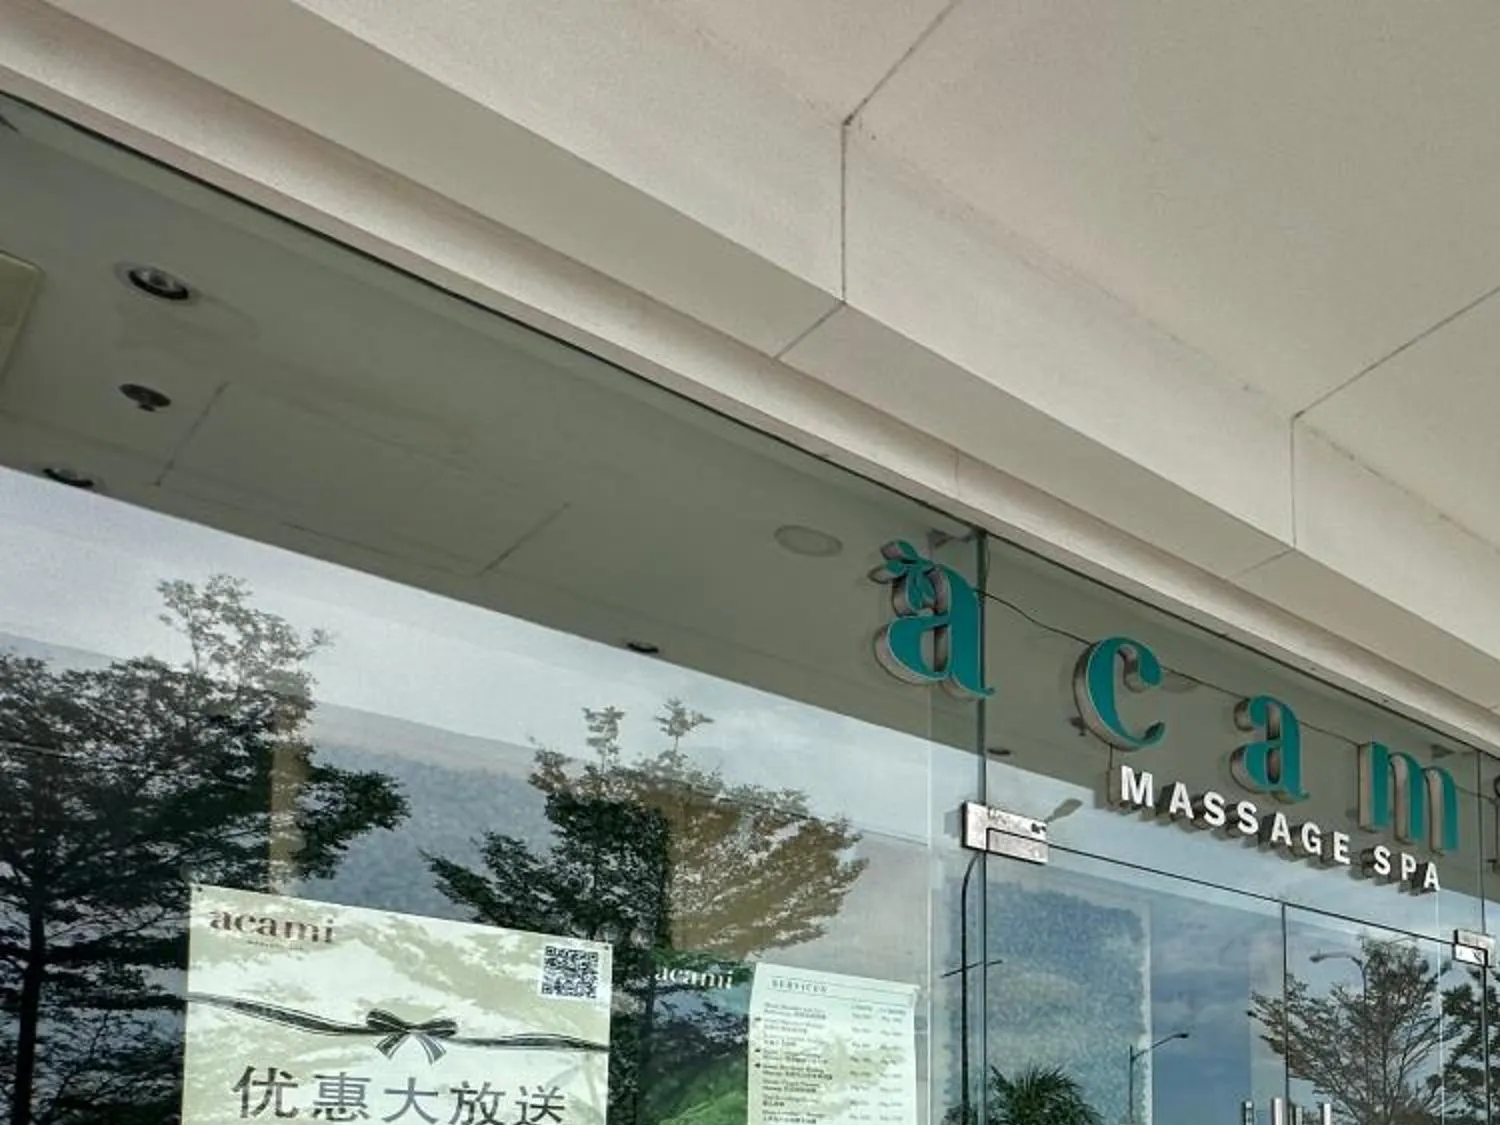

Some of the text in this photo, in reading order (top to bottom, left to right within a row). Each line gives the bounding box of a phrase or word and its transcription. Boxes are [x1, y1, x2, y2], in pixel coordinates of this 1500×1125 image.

[1120, 765, 1441, 893] MASSAGE SPA
[209, 911, 335, 943] acami
